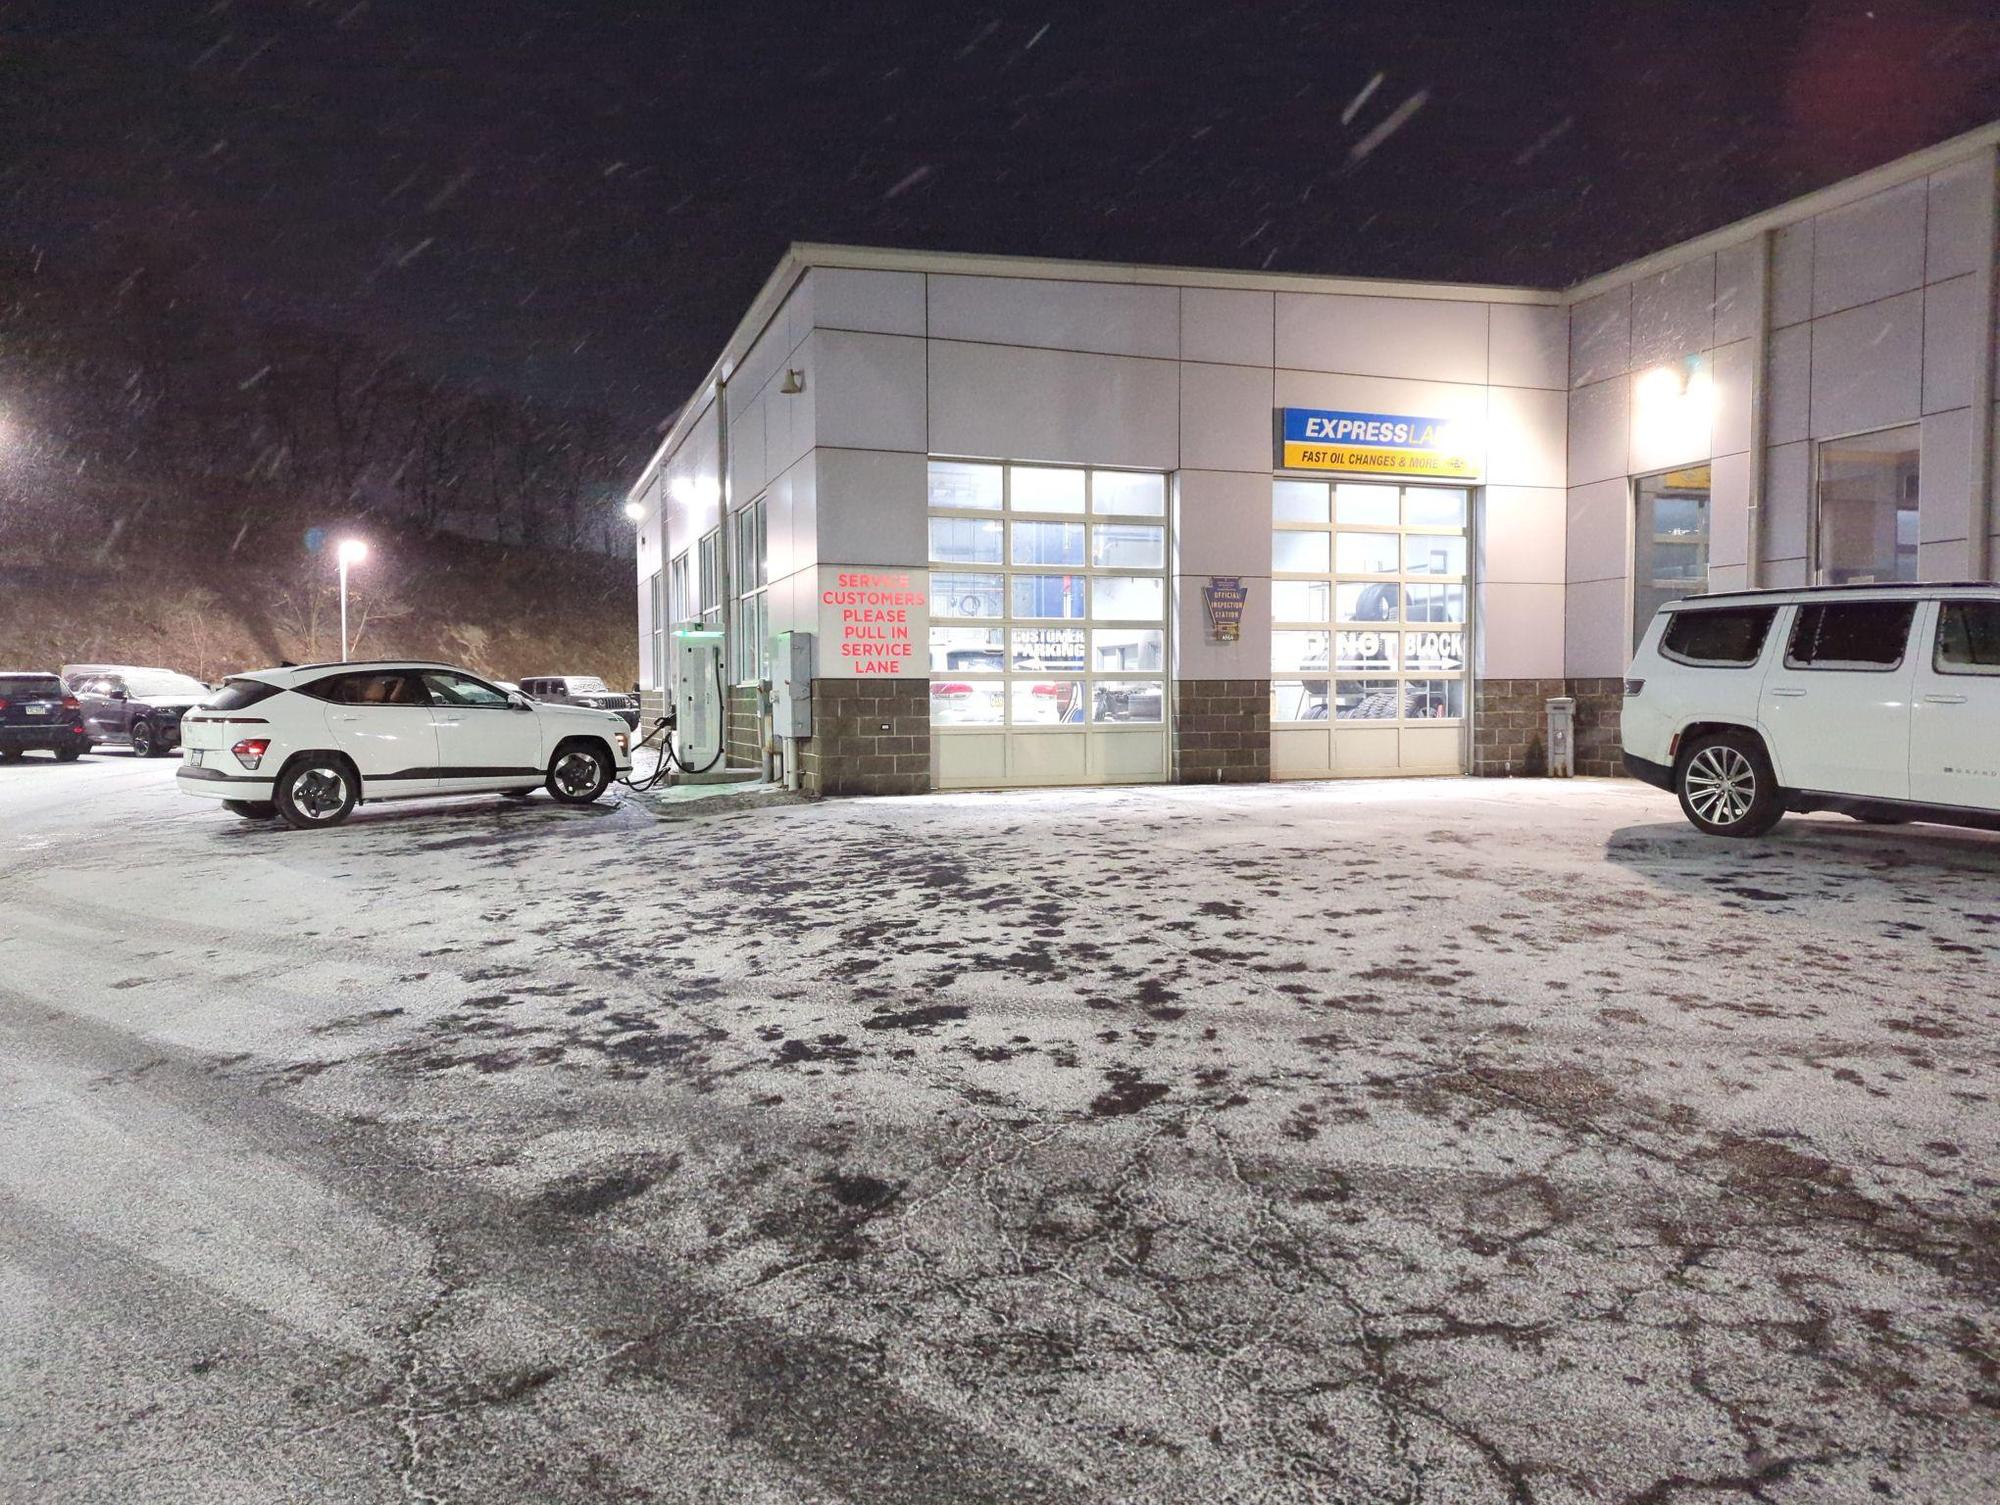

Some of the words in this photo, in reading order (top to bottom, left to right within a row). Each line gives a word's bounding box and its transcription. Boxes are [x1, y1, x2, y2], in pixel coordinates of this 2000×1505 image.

[1305, 417, 1441, 445] EXPRESSLA
[1301, 450, 1328, 463] FAST
[1330, 452, 1345, 464] OIL
[1348, 453, 1396, 467] CHANGES
[1398, 456, 1406, 468] &
[1409, 456, 1439, 469] MORE
[838, 573, 910, 588] SERVE
[823, 591, 925, 606] CUSTOMERS
[843, 609, 906, 622] PLEASE
[845, 626, 886, 639] PULL
[891, 626, 908, 639] IN
[1012, 628, 1085, 642] CUSTOMER
[841, 643, 912, 656] SERVICE
[1012, 643, 1085, 657] PARKING
[1305, 631, 1329, 656] D
[1336, 632, 1397, 657] NOT
[1405, 632, 1463, 656] BLOCK
[855, 661, 900, 673] LANE
